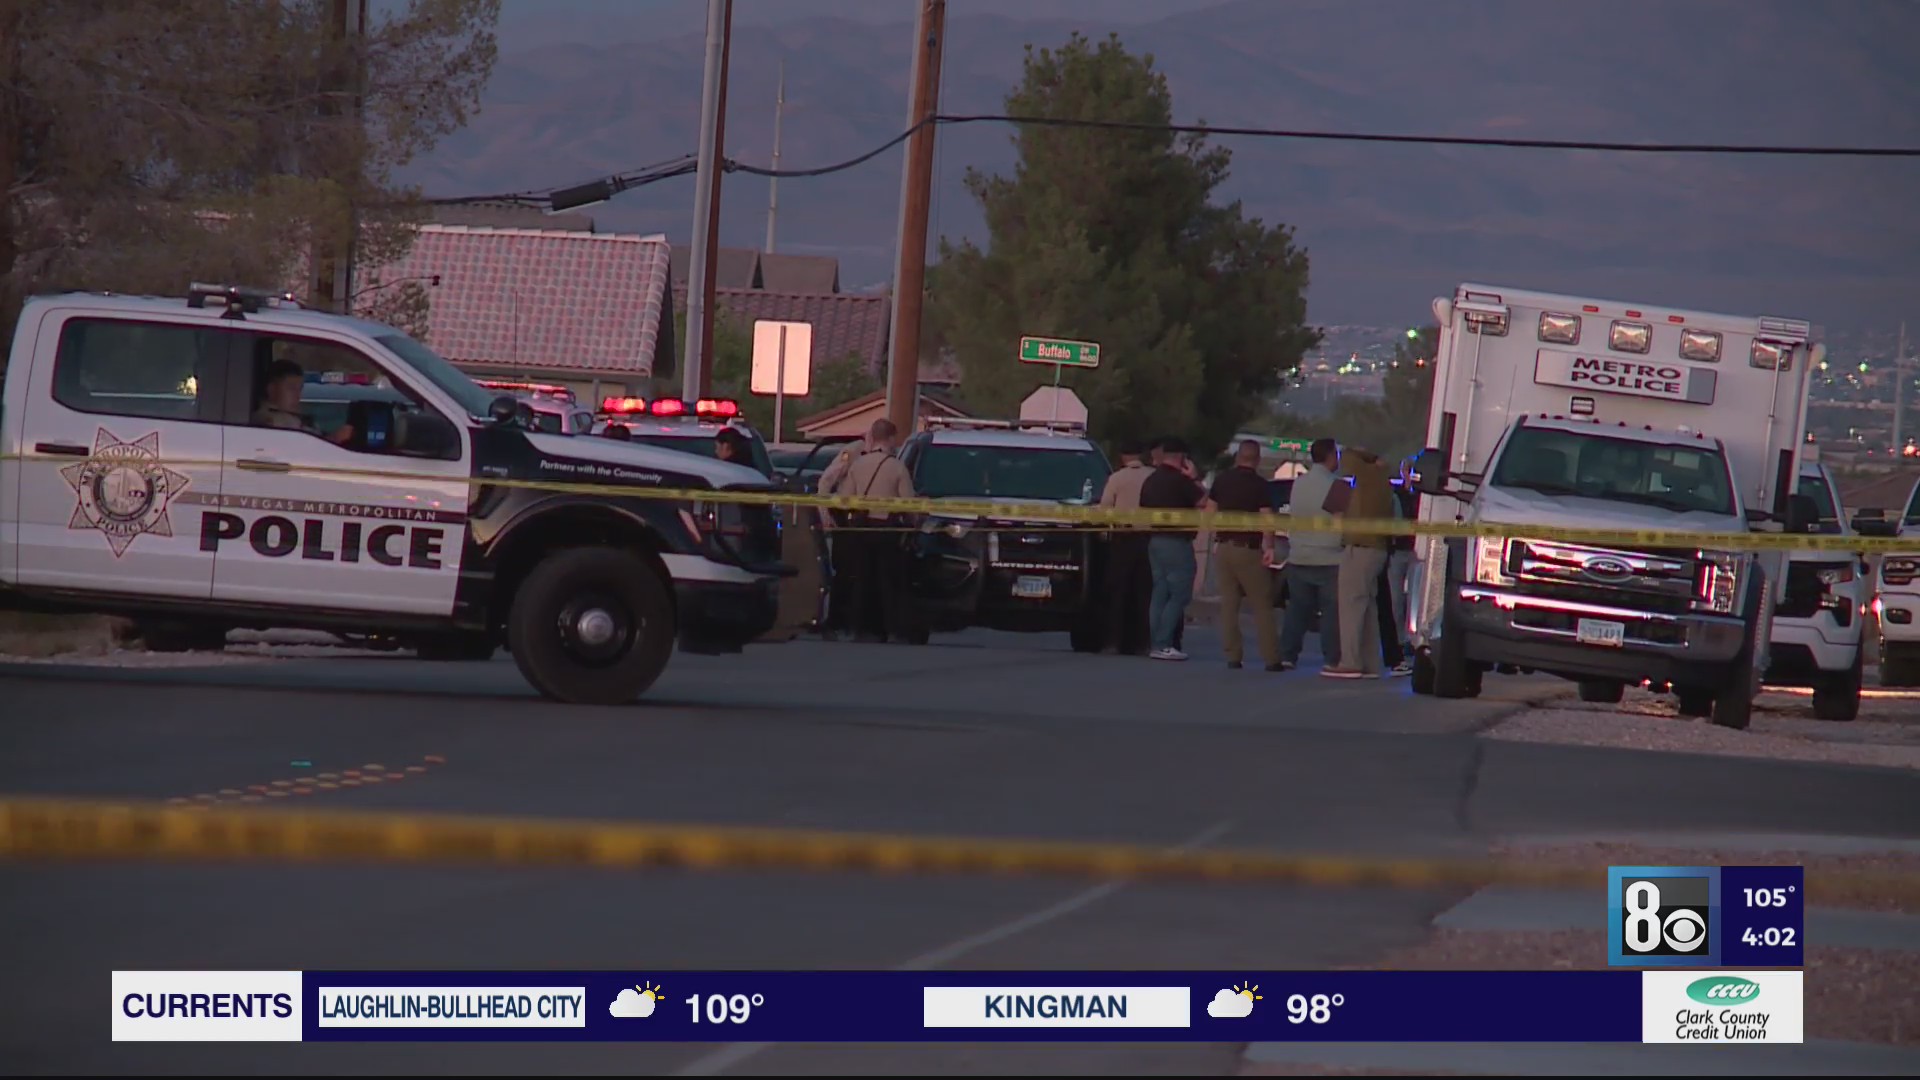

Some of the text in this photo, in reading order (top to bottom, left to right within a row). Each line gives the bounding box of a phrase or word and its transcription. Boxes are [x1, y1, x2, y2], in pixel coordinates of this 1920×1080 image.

[1038, 343, 1071, 359] Buffalo
[1573, 358, 1681, 379] METRO
[1571, 371, 1681, 393] POLICE
[540, 459, 663, 484] Partners with the Community
[200, 495, 437, 522] LAS VEGAS METROPOLITAN
[199, 510, 445, 570] POLICE
